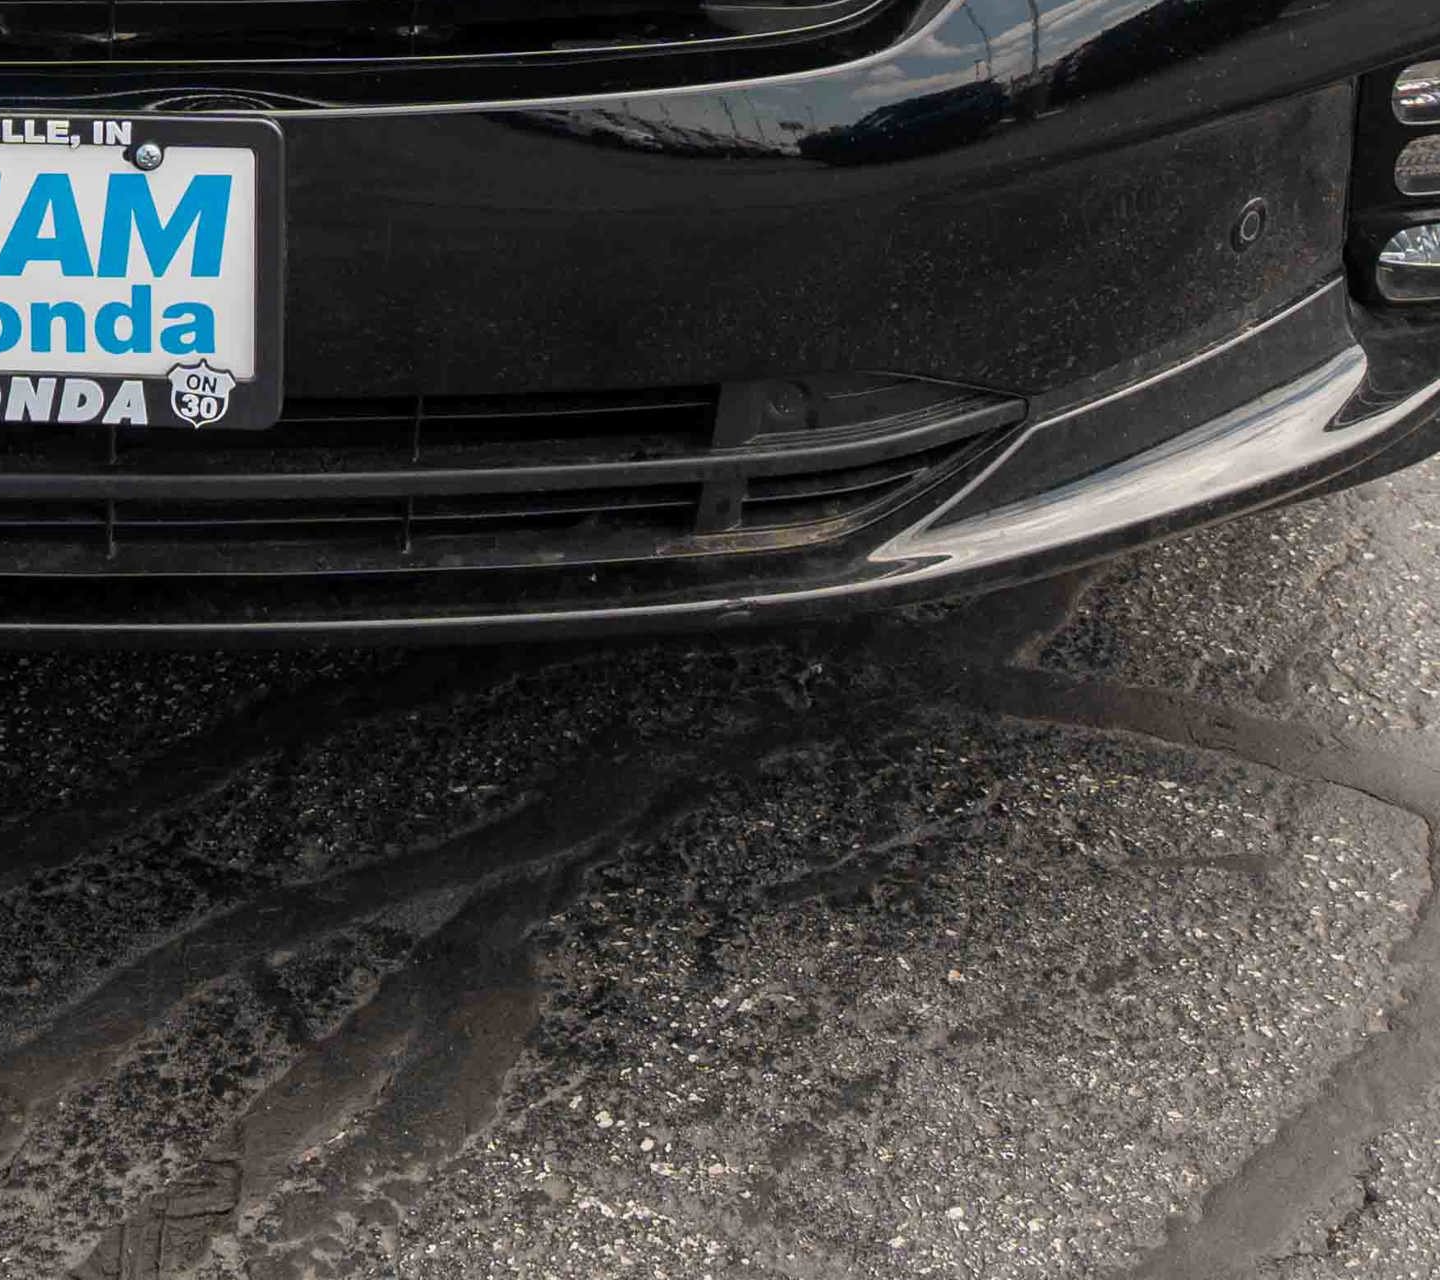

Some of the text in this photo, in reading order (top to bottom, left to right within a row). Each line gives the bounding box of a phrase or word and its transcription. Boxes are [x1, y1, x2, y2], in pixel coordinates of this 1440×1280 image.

[93, 119, 133, 145] IN
[186, 373, 218, 394] ON
[180, 393, 218, 419] 30
